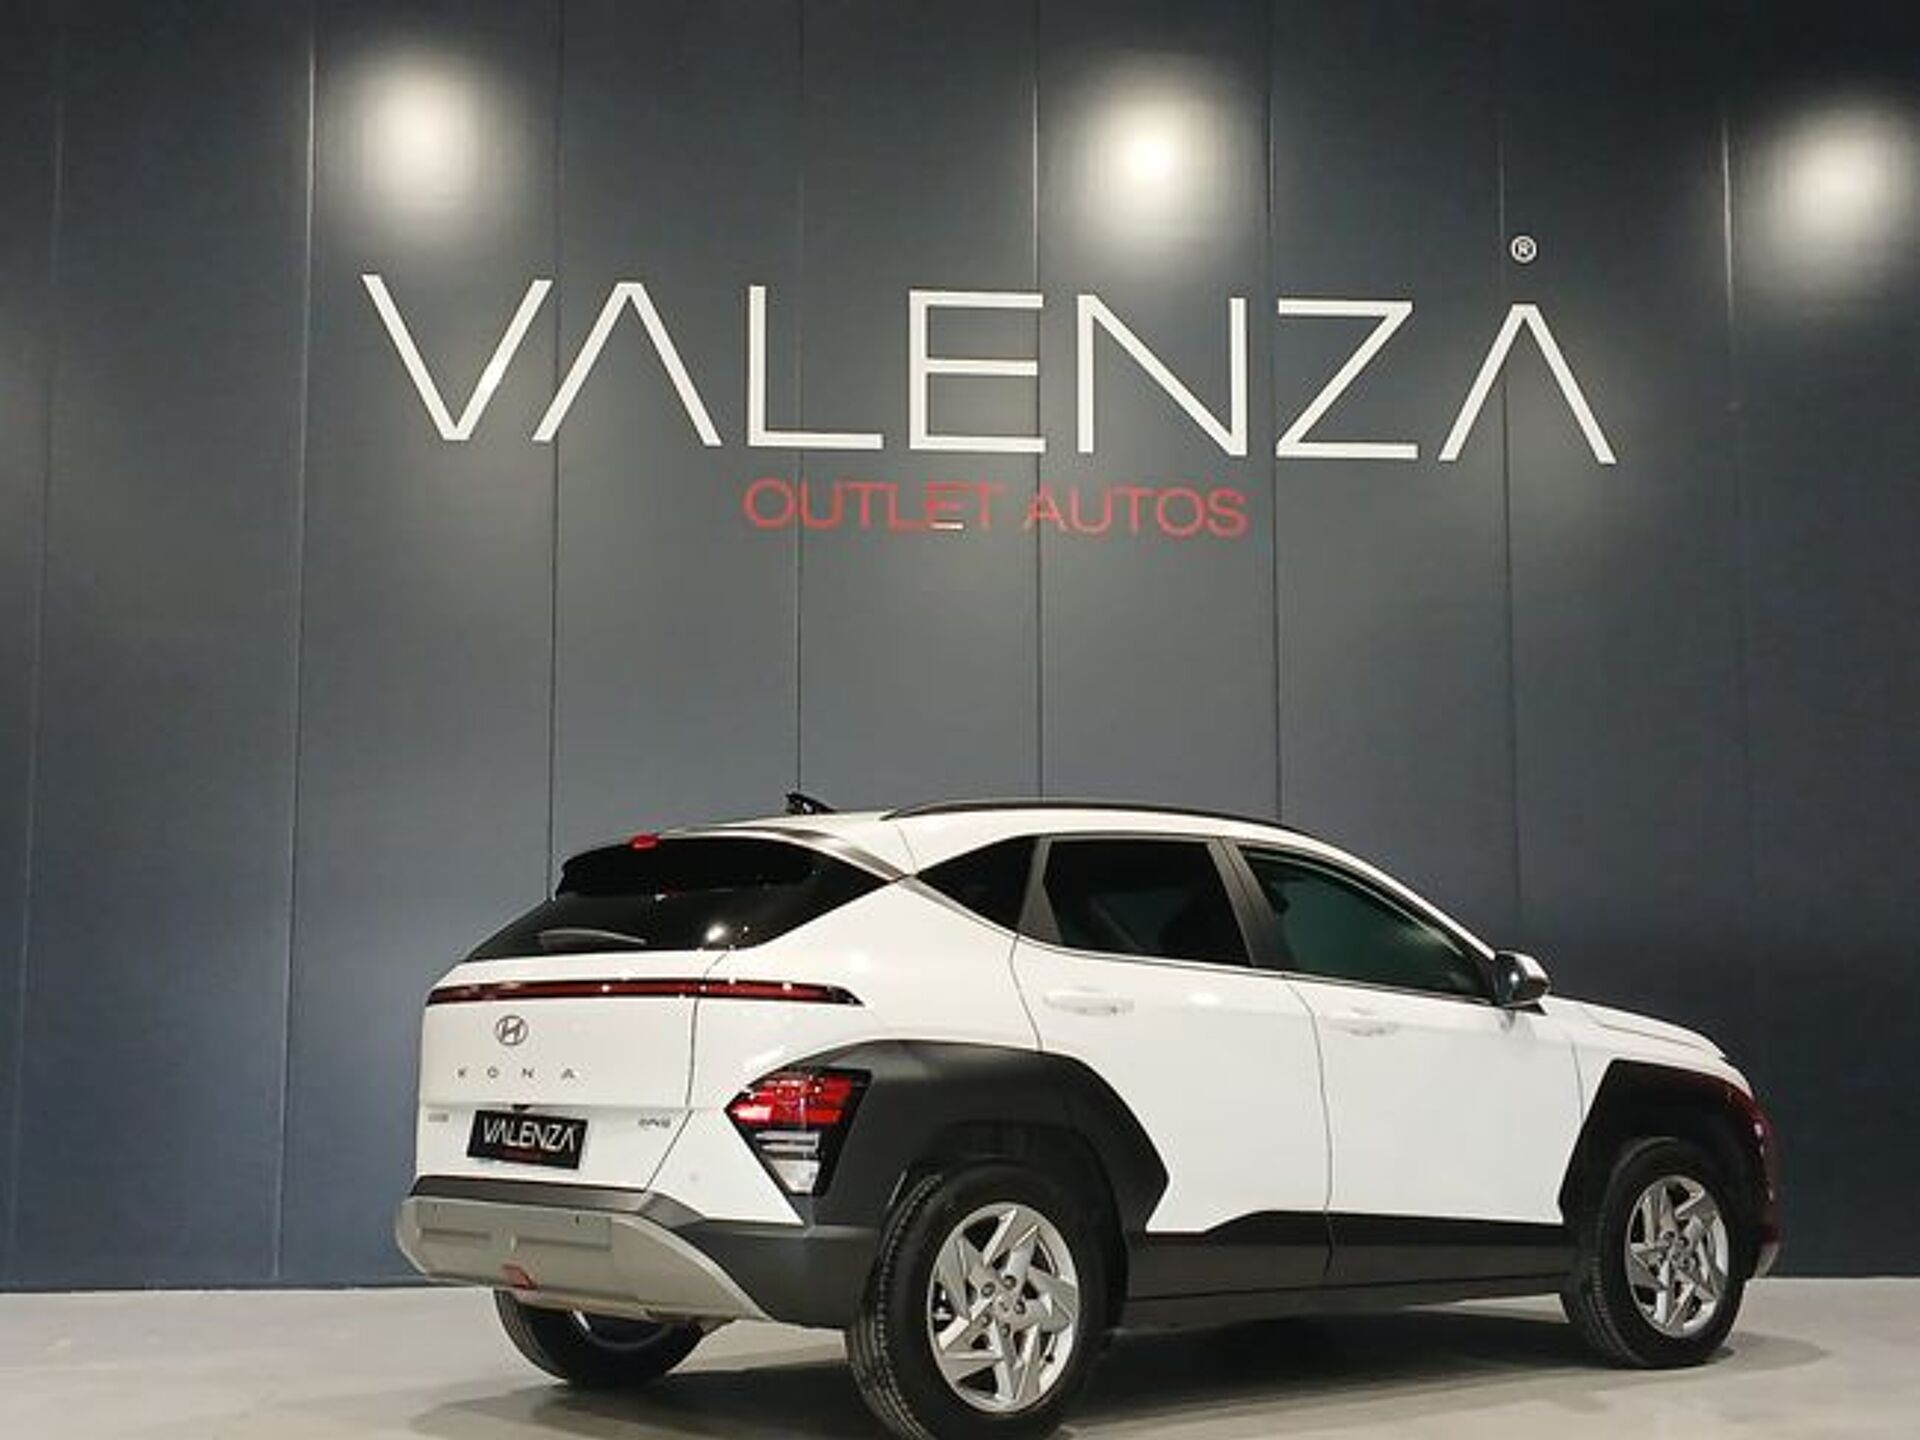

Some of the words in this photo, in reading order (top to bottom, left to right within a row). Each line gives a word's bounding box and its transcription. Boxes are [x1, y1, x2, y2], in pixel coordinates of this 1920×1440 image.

[361, 273, 1617, 465] VALENZA
[743, 477, 1003, 532] OUTLET
[1024, 485, 1249, 538] AUTOS
[456, 1066, 575, 1079] KONA
[482, 1117, 576, 1152] VALENZA
